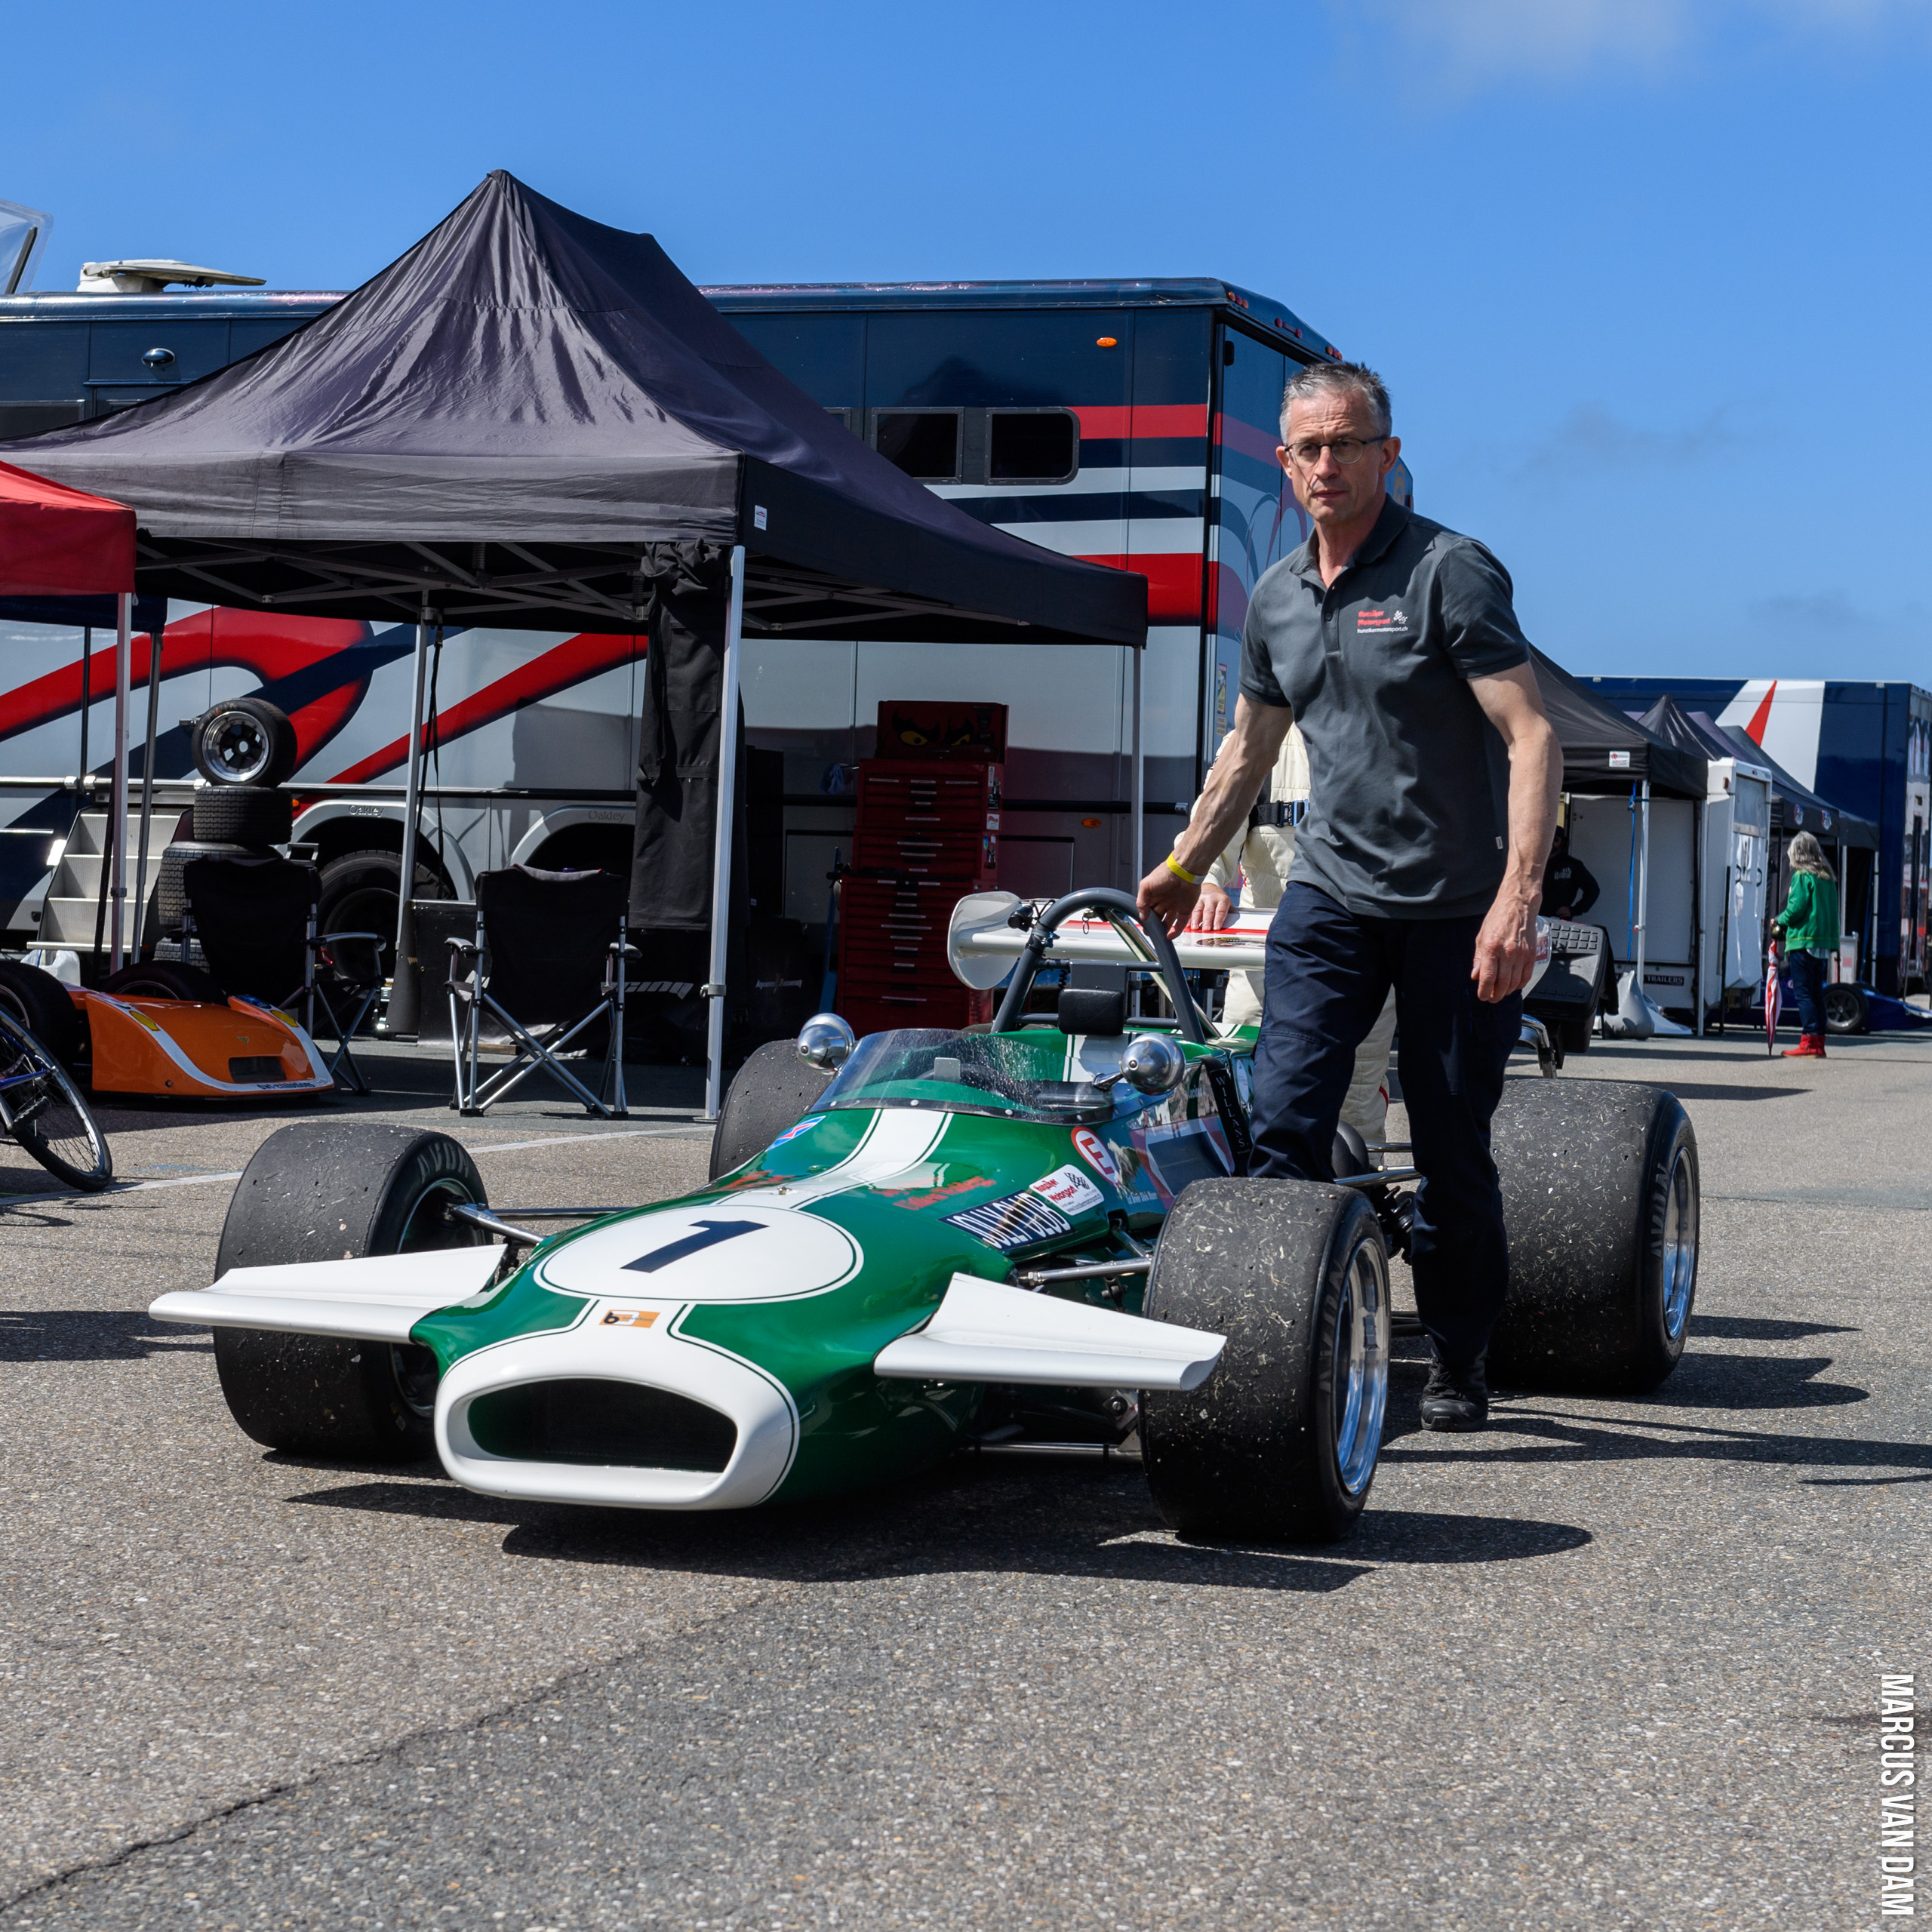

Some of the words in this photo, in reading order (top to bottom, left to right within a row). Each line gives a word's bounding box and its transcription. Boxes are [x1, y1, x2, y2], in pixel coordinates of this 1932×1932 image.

[349, 805, 384, 817] Oakley
[589, 810, 626, 823] Oakley
[1647, 975, 1683, 983] TRAILERS
[417, 1143, 469, 1183] AVON
[1080, 1137, 1115, 1175] E
[947, 1207, 1033, 1249] JOLLY
[992, 1192, 1071, 1238] CLUB
[1651, 1163, 1670, 1260] AVON
[620, 1220, 771, 1273] 1
[1319, 1260, 1345, 1395] AVON
